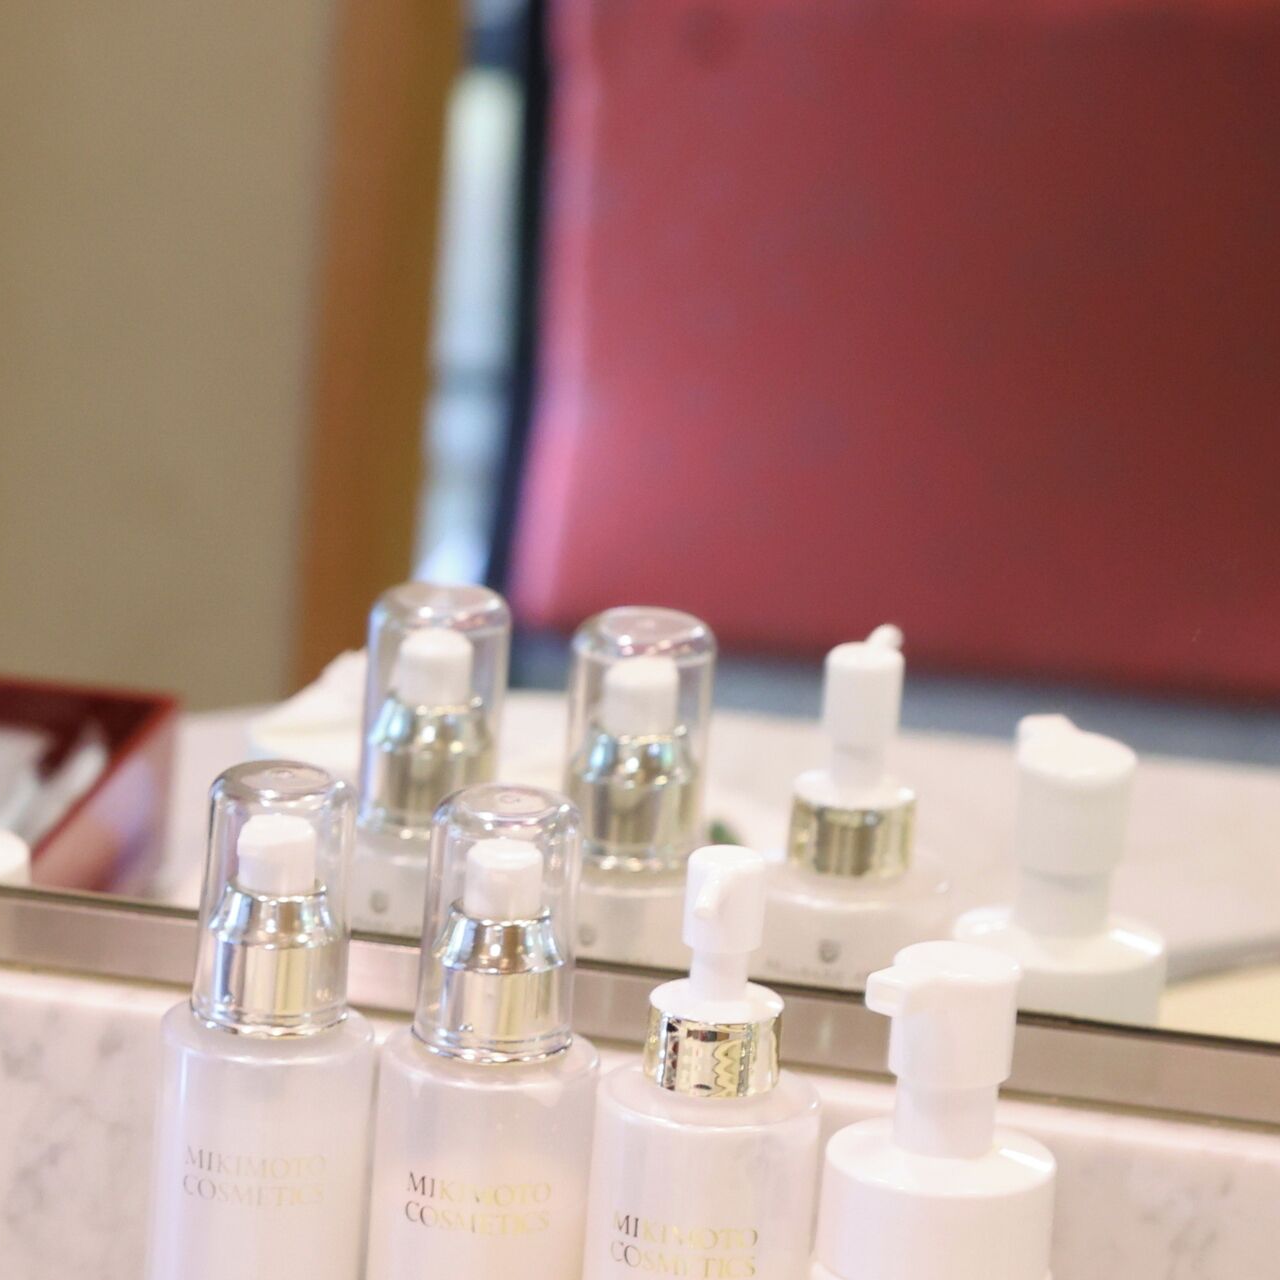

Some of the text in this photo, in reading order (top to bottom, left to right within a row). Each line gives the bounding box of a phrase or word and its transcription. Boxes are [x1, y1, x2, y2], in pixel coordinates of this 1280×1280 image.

[183, 1144, 328, 1180] MIKIMOTO
[182, 1173, 325, 1207] COSMETICS
[406, 1169, 553, 1207] MIKIMOTO
[612, 1210, 759, 1250] MIKIMOTO
